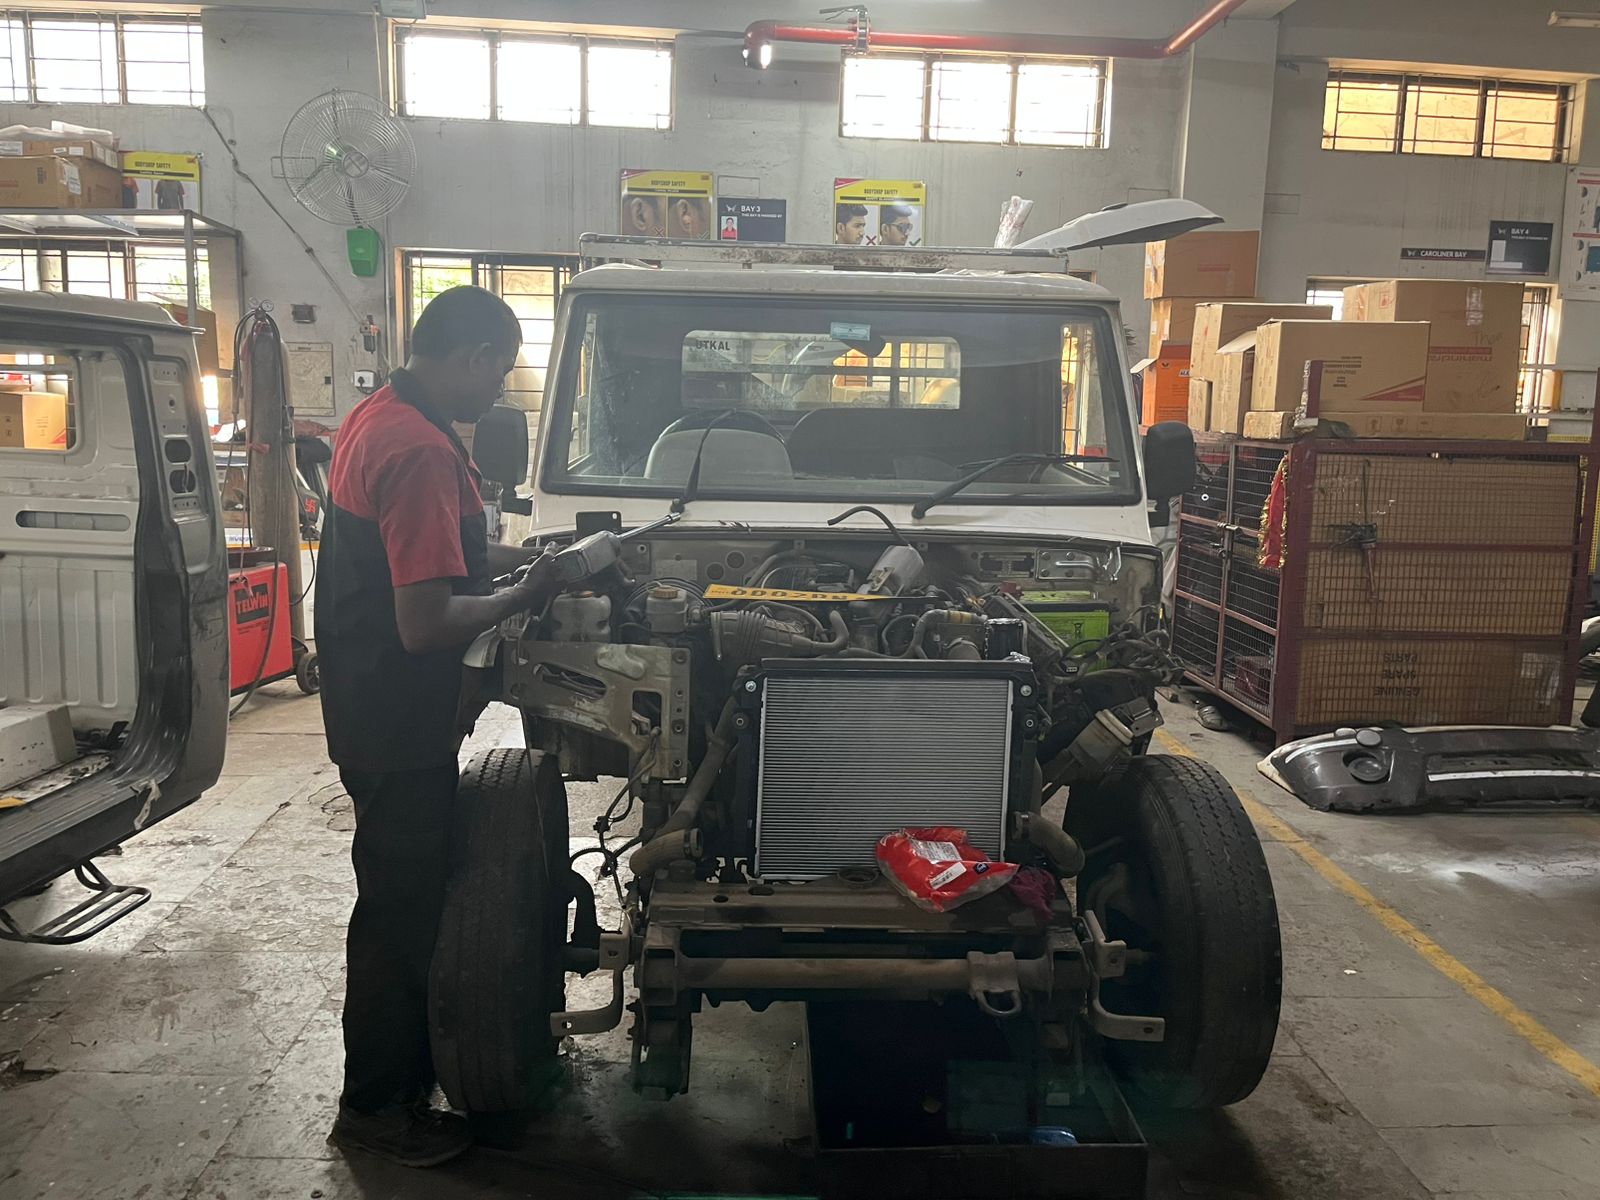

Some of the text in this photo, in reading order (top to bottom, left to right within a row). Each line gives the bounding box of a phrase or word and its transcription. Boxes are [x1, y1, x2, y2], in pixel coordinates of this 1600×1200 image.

[1455, 251, 1467, 259] BAY
[695, 339, 731, 351] UTKAL
[236, 592, 269, 614] TELWIN
[1383, 653, 1418, 663] PARTS
